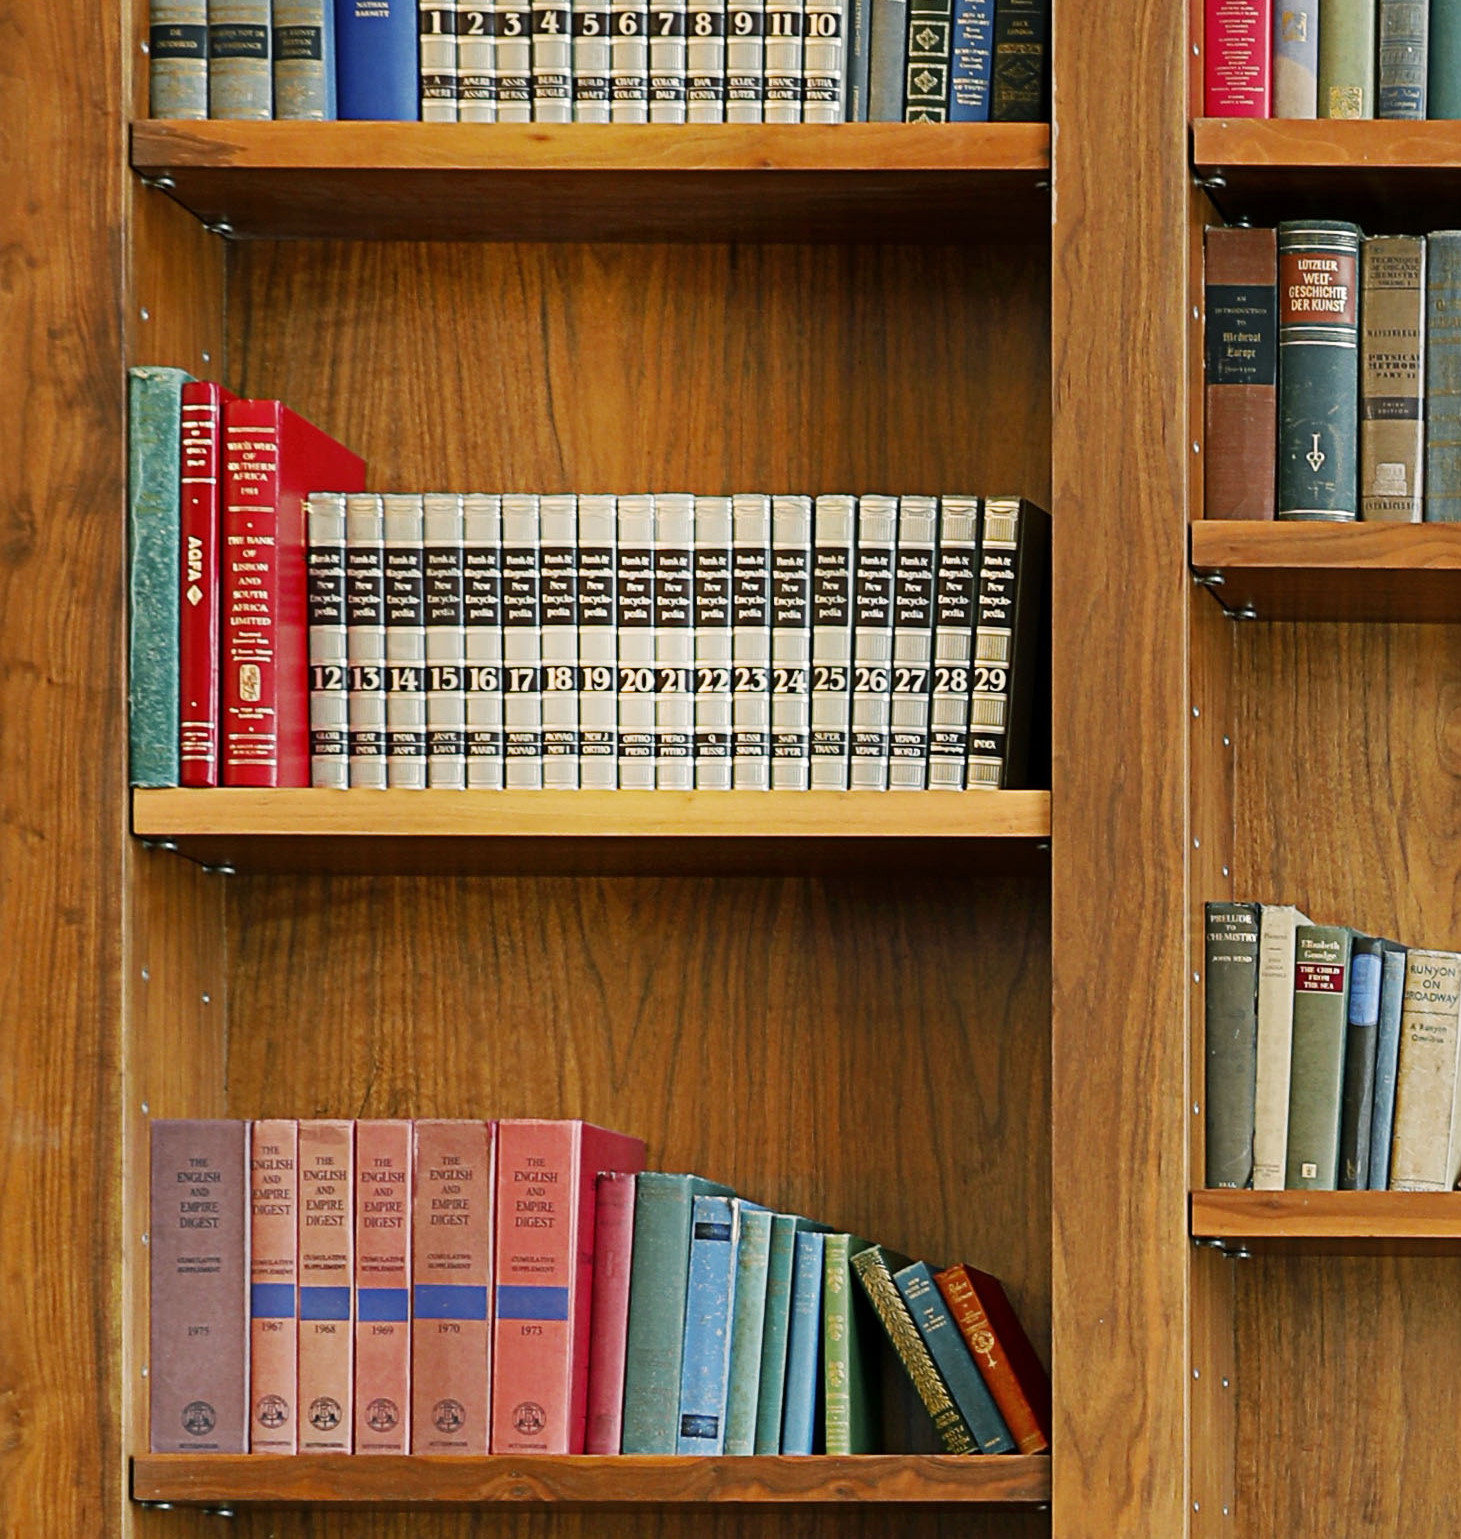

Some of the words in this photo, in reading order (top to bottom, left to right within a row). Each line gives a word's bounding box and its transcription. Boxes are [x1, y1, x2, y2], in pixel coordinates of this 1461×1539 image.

[430, 11, 441, 34] 1
[467, 13, 484, 35] 2
[503, 13, 521, 36] 3
[541, 11, 559, 34] 4
[582, 13, 599, 36] 5
[619, 12, 637, 35] 6
[659, 13, 675, 35] 7
[694, 13, 712, 36] 8
[735, 13, 752, 36] 9
[771, 13, 792, 36] 11
[808, 13, 835, 36] 10
[1304, 273, 1332, 284] WELT-
[1289, 286, 1347, 300] GESCHICHTE
[1291, 300, 1309, 312] DER
[1312, 300, 1345, 313] KUNST
[314, 667, 342, 690] 12
[353, 667, 380, 690] 13
[391, 667, 418, 691] 14
[430, 666, 458, 690] 15
[470, 667, 498, 691] 16
[510, 668, 534, 691] 17
[546, 666, 572, 690] 18
[583, 666, 611, 690] 19
[620, 669, 655, 692] 20
[661, 669, 687, 692] 21
[697, 669, 729, 692] 22
[735, 667, 768, 691] 23
[773, 670, 806, 693] 24
[814, 667, 846, 691] 25
[855, 668, 887, 692] 26
[895, 669, 927, 692] 27
[935, 668, 968, 692] 28
[974, 668, 1006, 692] 29
[1210, 914, 1251, 924] PRELUDE
[1411, 965, 1455, 978] RUNYON
[1423, 979, 1440, 989] ON
[303, 1170, 347, 1181] ENGLISH
[306, 1200, 343, 1210] EMPIRE
[306, 1215, 344, 1227] DIGEST
